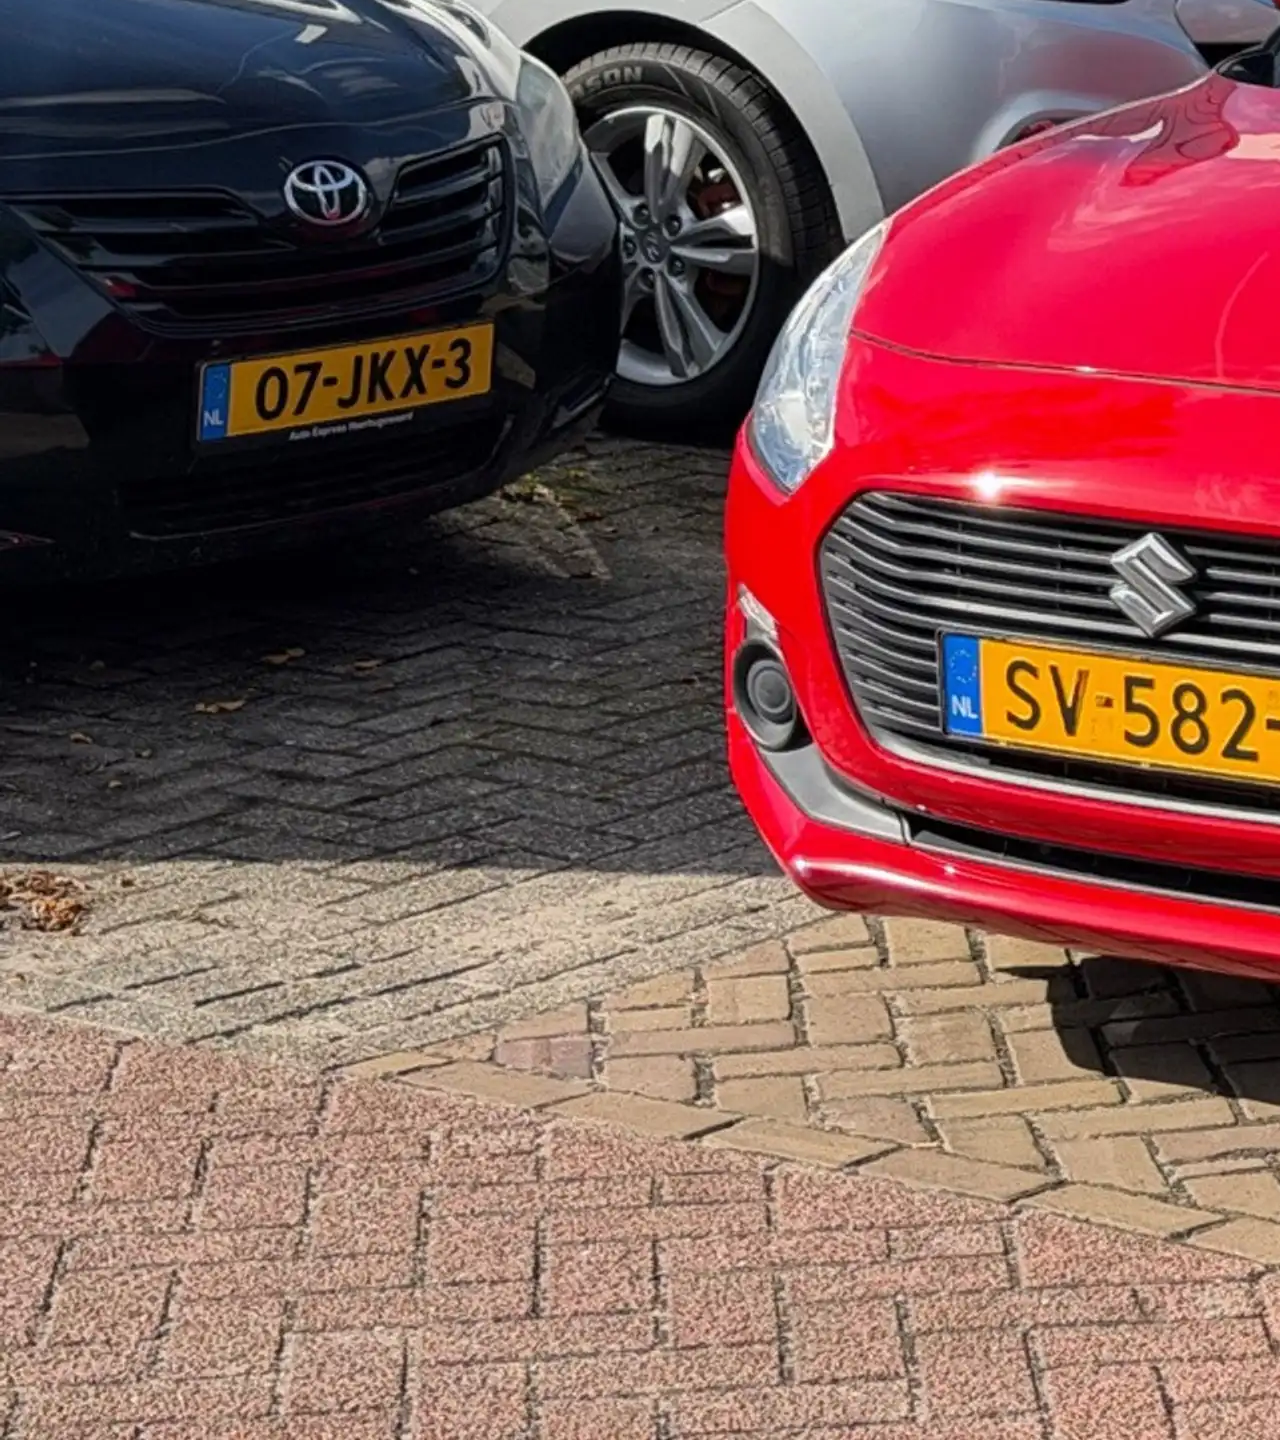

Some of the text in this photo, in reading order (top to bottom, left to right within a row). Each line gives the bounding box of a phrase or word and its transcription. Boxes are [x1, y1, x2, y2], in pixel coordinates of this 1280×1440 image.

[203, 337, 473, 427] NL 07-JKX-3
[951, 693, 978, 720] NL
